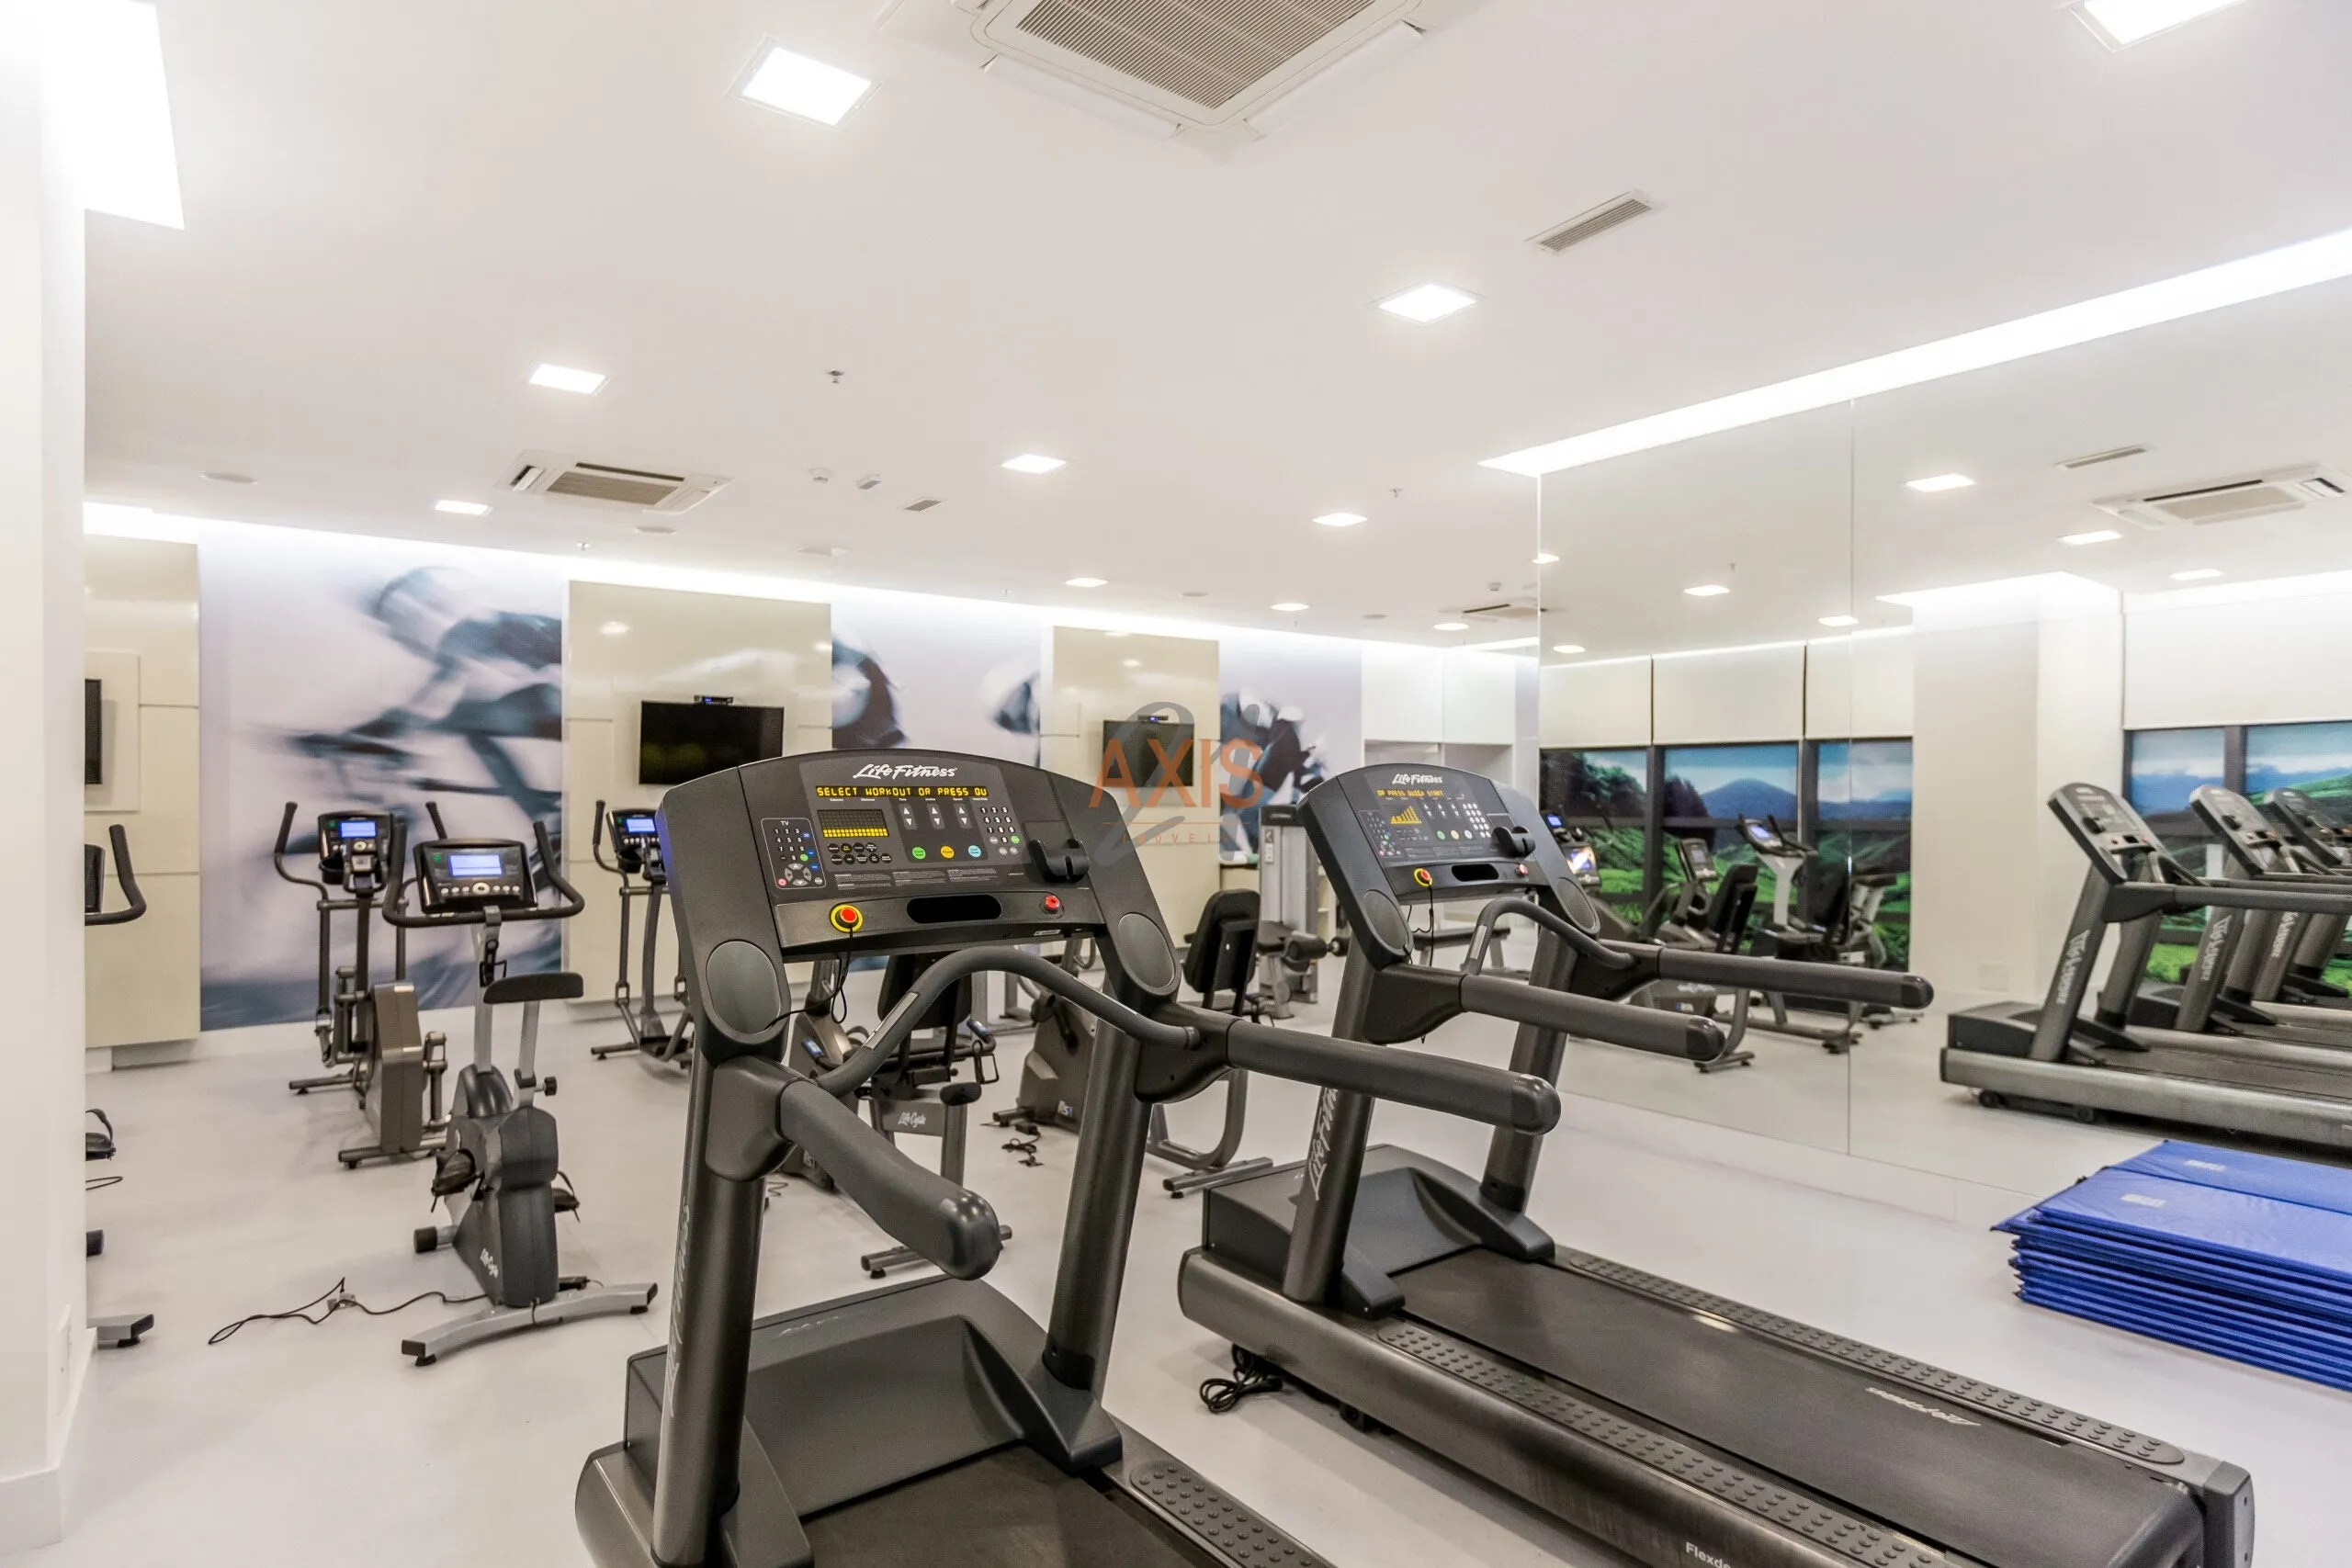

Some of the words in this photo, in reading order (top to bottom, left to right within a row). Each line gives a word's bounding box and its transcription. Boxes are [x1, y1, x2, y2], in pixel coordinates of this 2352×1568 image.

[853, 763, 893, 780] Life
[892, 764, 957, 780] Fitness
[816, 787, 857, 797] SELECT
[865, 787, 911, 797] WORKOUT
[919, 787, 931, 796] OR
[937, 787, 968, 796] PRESS
